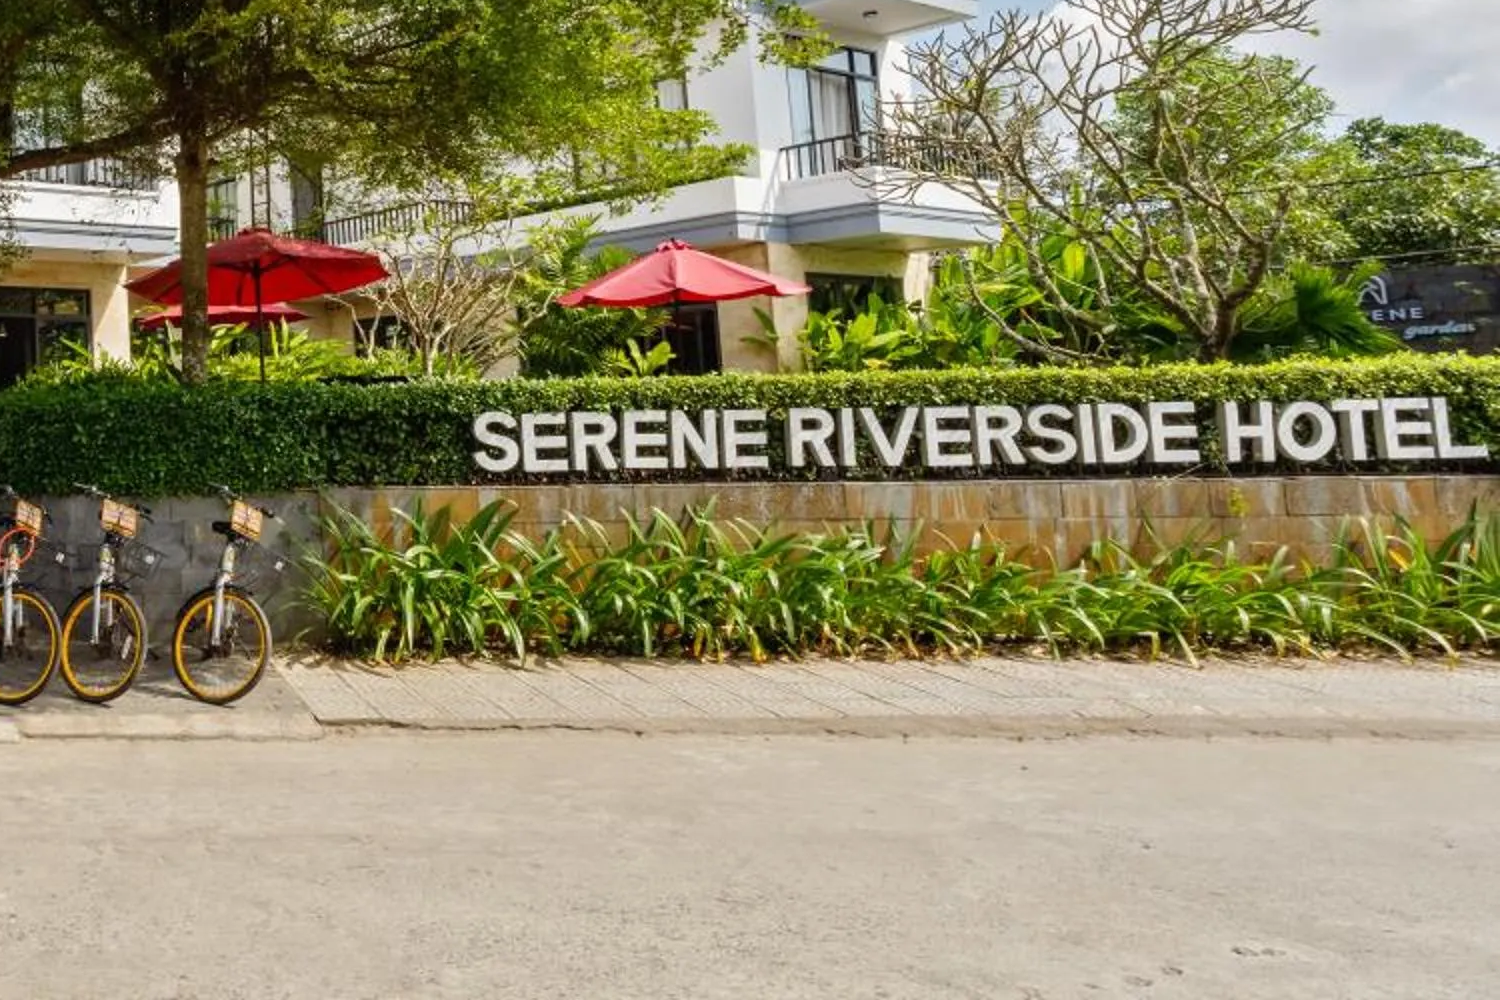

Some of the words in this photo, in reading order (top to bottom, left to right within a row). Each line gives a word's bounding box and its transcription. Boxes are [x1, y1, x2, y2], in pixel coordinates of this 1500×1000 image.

[1371, 307, 1423, 320] ENE
[473, 408, 769, 472] SERENE
[788, 401, 1200, 467] RIVERSIDE
[1223, 396, 1489, 463] HOTEL
